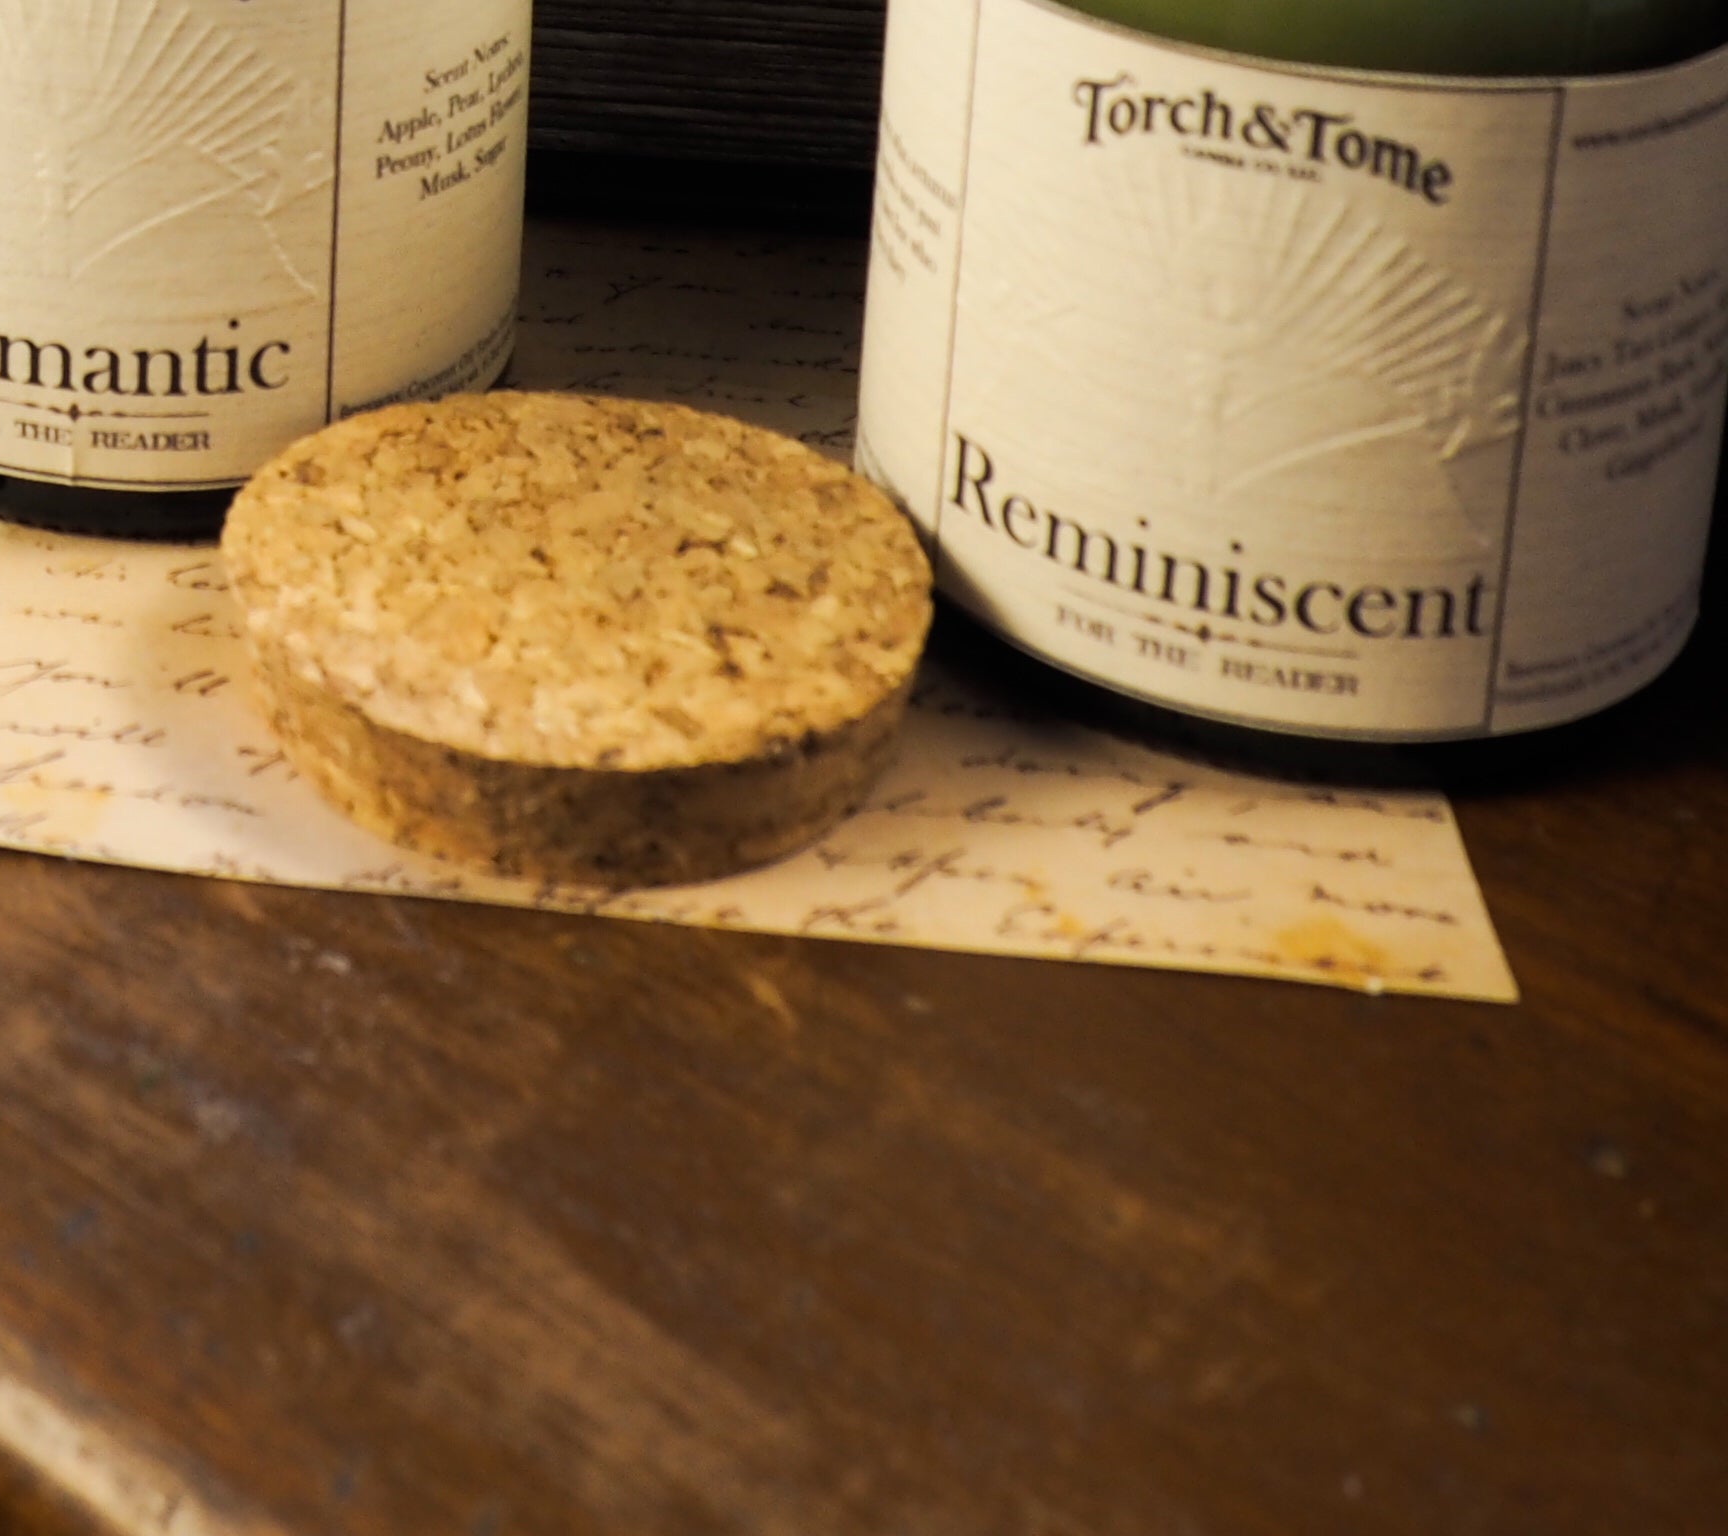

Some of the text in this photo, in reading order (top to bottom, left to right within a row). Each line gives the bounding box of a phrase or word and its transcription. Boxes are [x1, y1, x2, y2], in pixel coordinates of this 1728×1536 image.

[377, 106, 444, 144] Apple,
[13, 418, 73, 447] THE
[89, 428, 212, 453] READER
[948, 432, 1488, 640] Reminiscent
[1054, 603, 1361, 698] FOR THE READER
